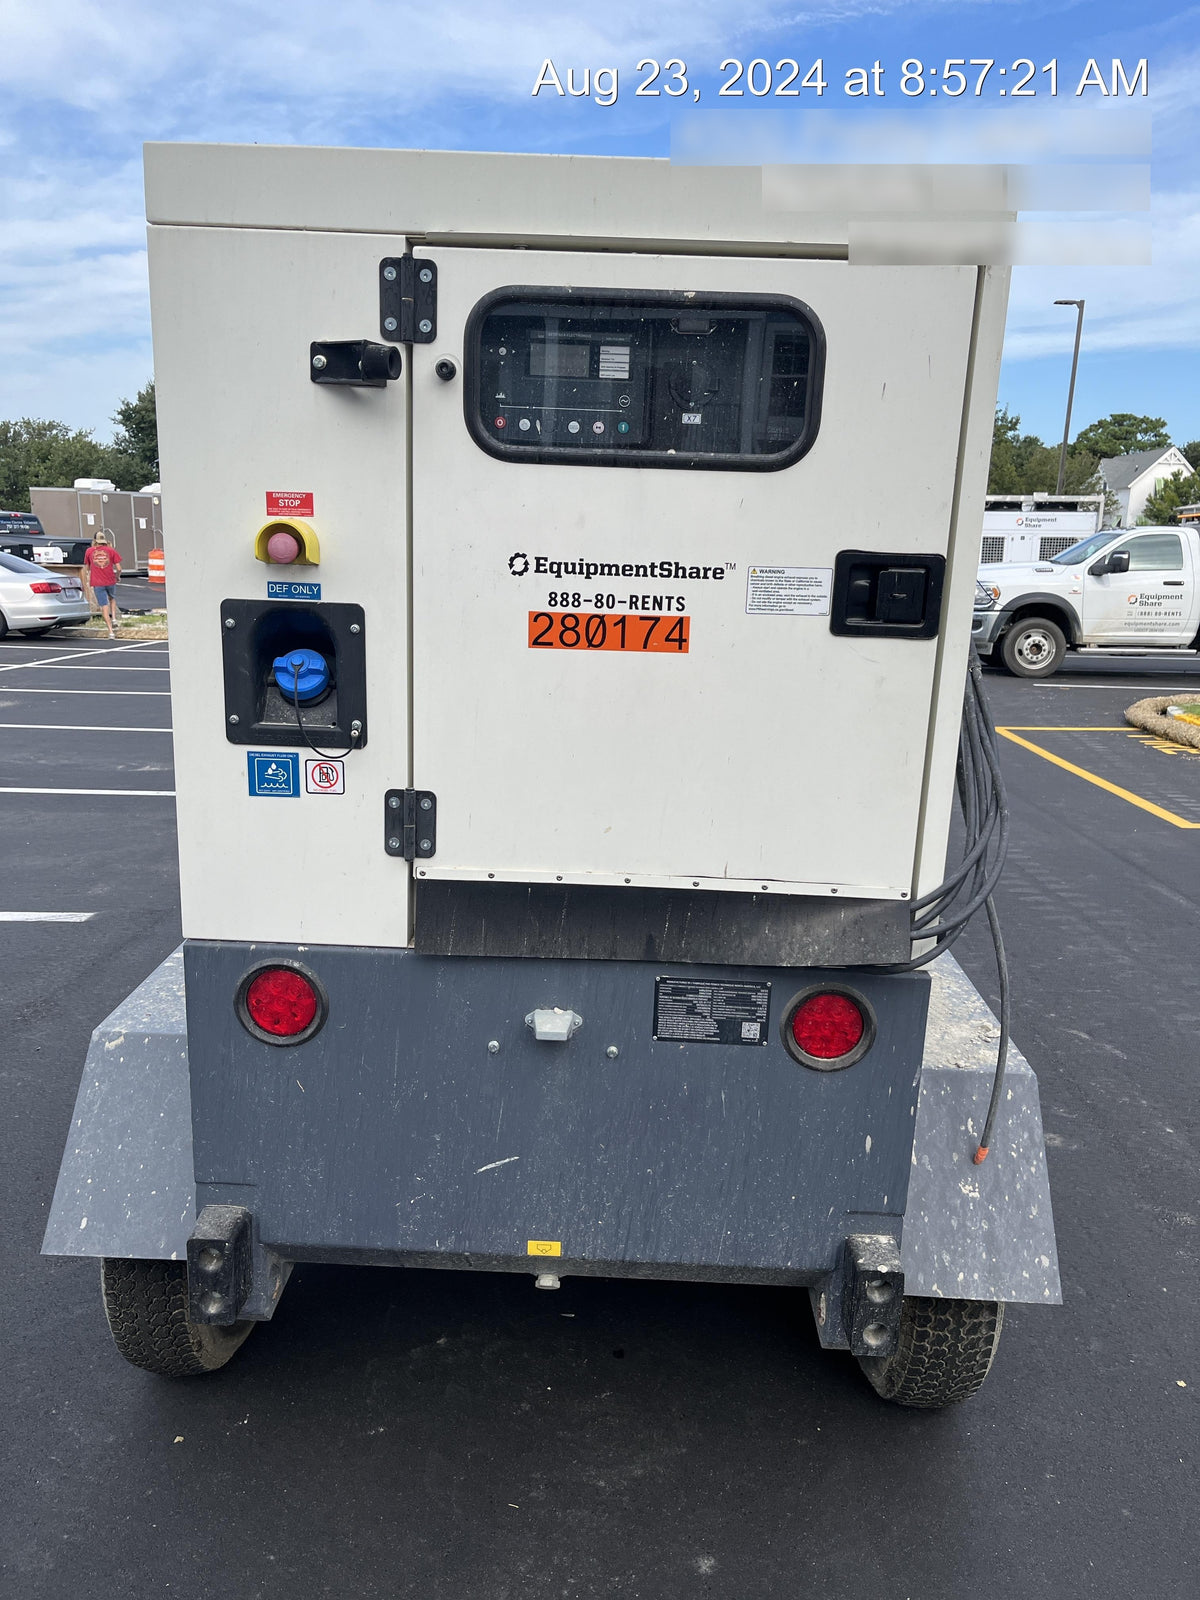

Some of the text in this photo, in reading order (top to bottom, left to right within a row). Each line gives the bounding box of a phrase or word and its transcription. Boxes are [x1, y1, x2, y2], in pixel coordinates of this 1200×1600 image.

[278, 498, 301, 507] STOP
[533, 556, 725, 580] EquipmentShare
[268, 583, 319, 595] DEF ONLY
[1139, 593, 1183, 601] Equipment
[547, 591, 686, 612] 888-80-RENTS
[531, 611, 688, 651] 280174
